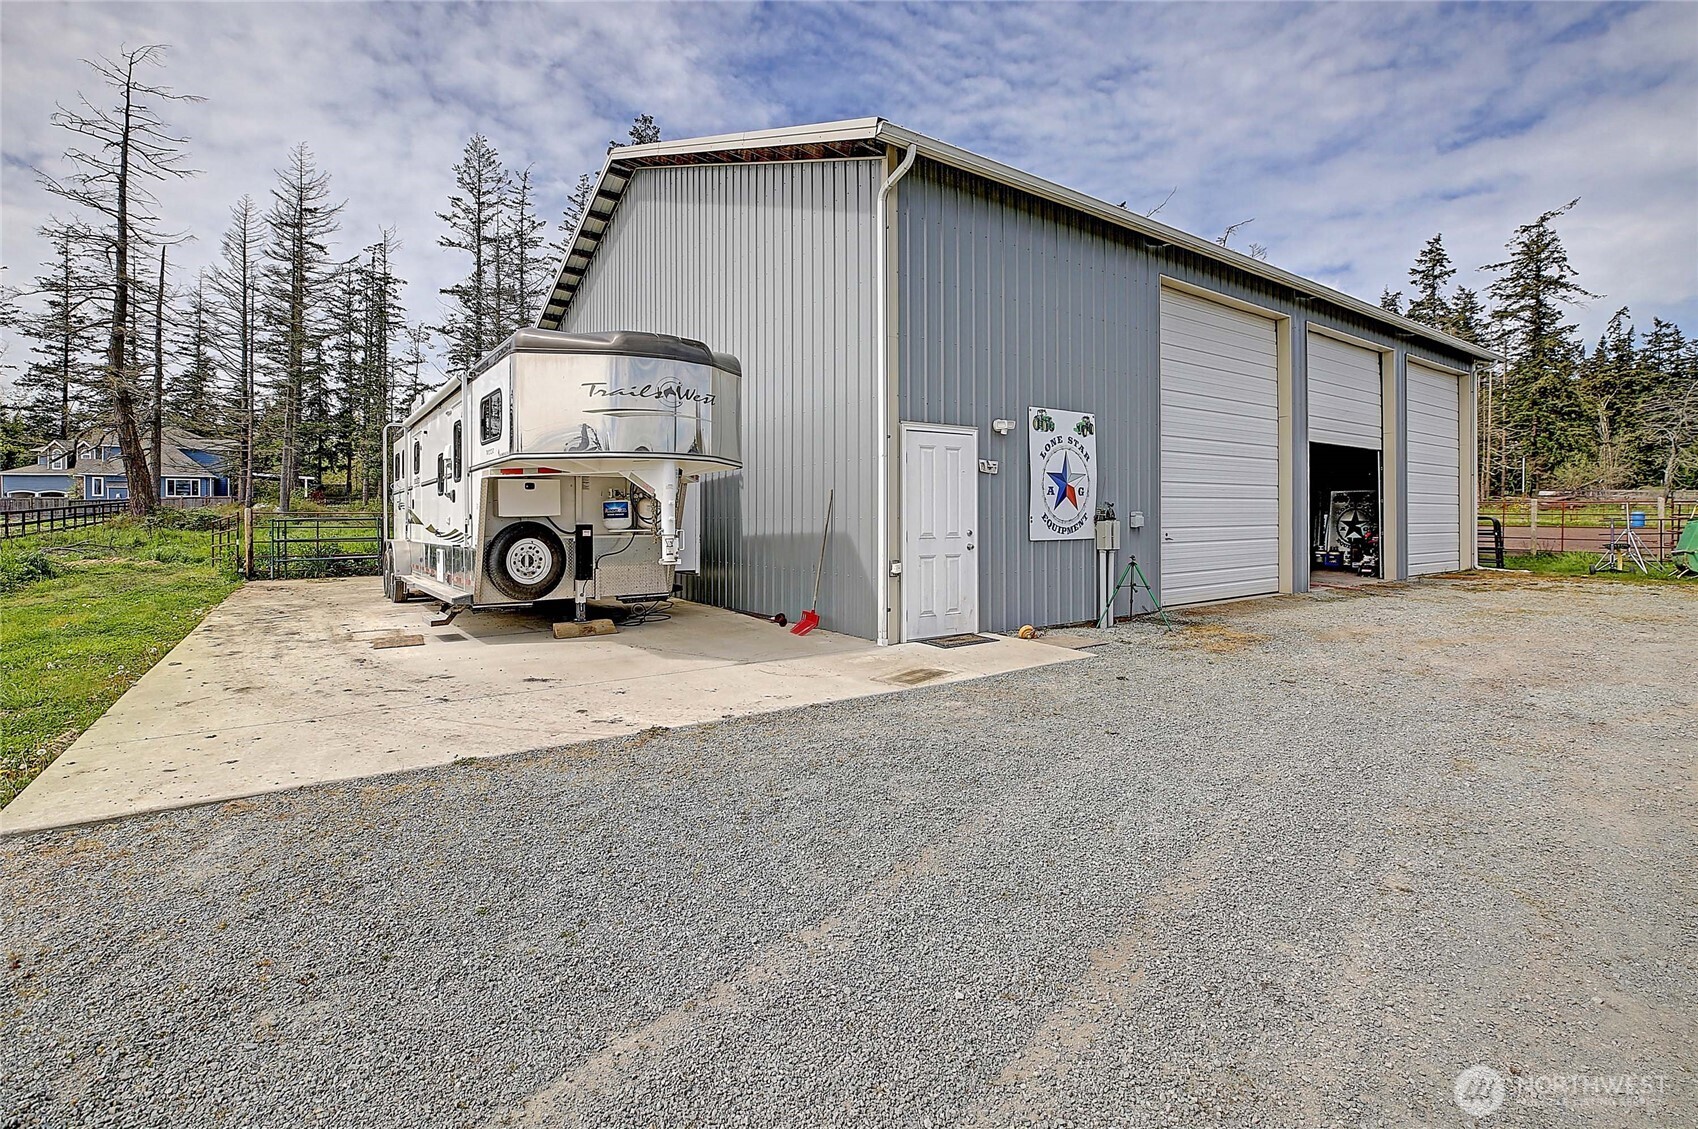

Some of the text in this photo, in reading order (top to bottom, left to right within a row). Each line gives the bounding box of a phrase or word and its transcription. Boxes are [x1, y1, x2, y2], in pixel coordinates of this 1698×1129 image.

[581, 382, 716, 405] Trails West
[1040, 435, 1090, 462] LONE STAR
[1047, 486, 1085, 496] A G
[1041, 512, 1088, 535] EQUIPMENT
